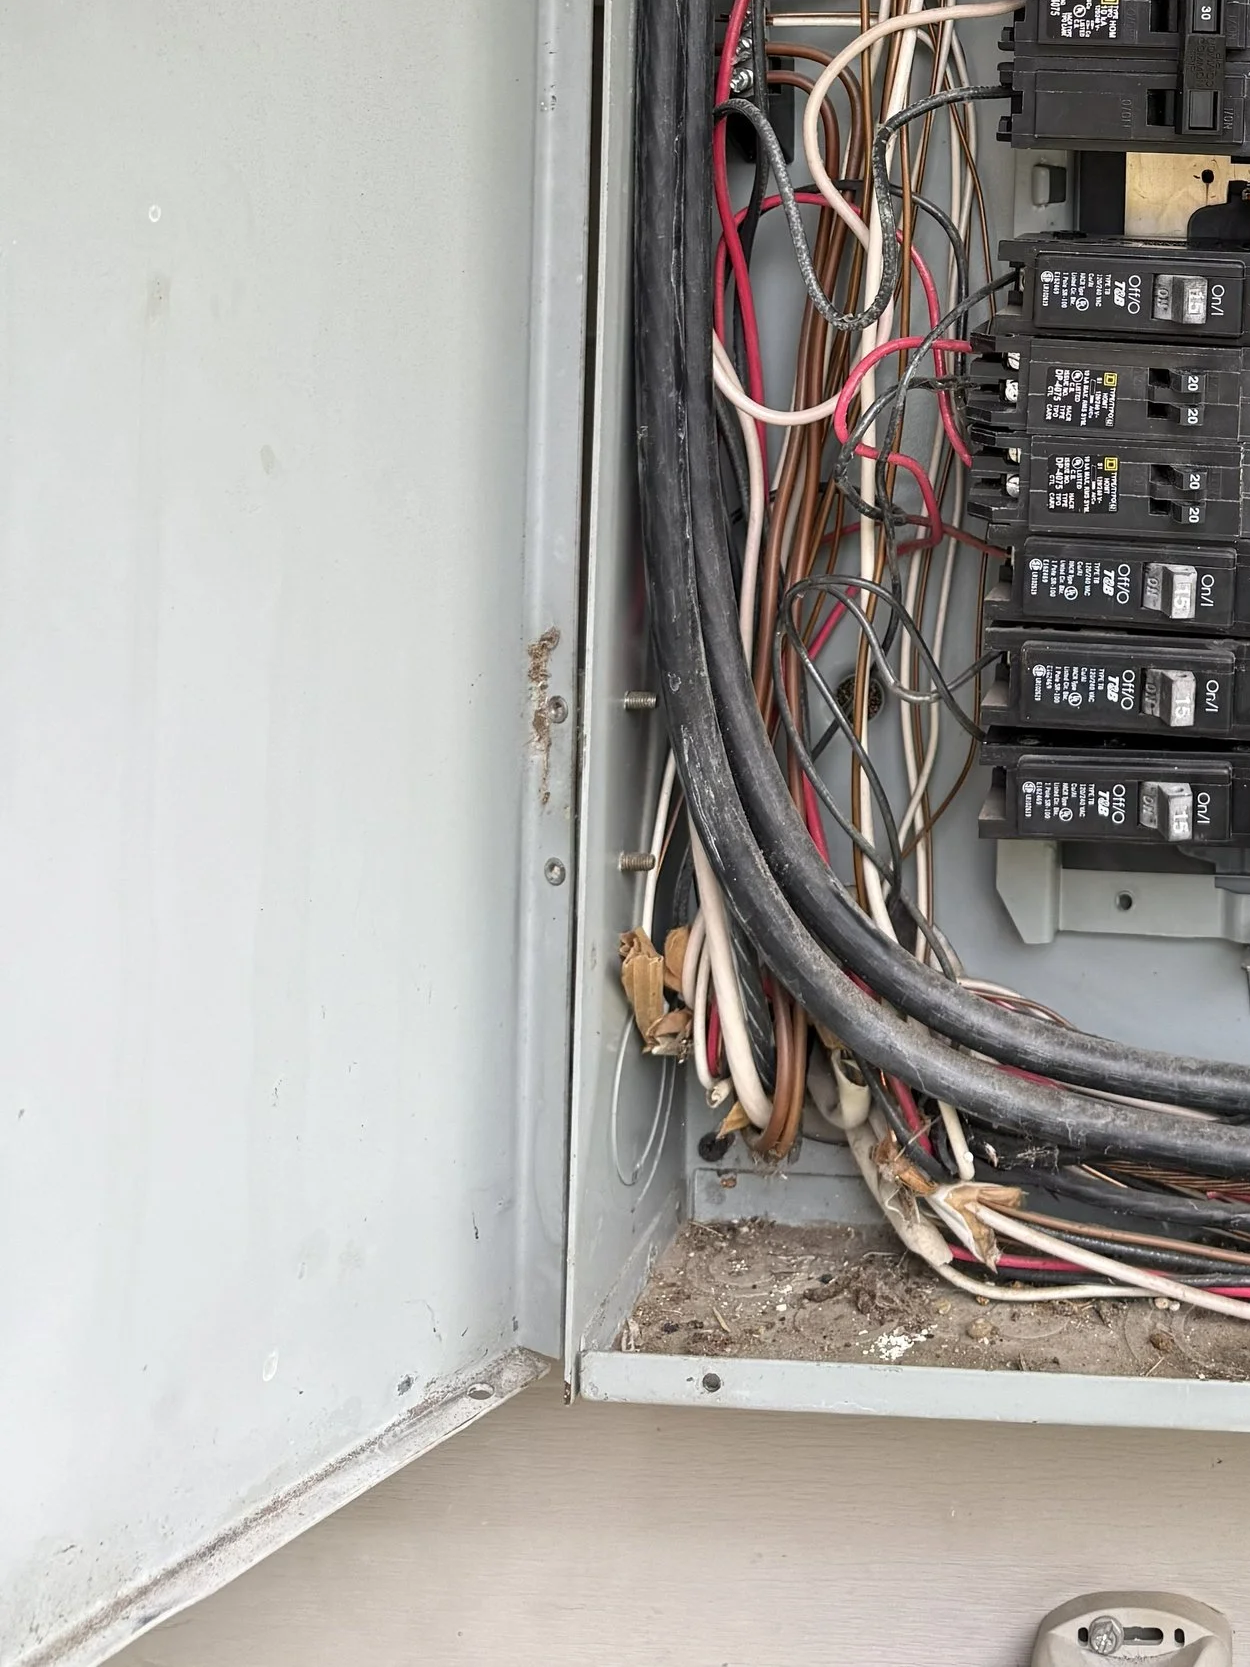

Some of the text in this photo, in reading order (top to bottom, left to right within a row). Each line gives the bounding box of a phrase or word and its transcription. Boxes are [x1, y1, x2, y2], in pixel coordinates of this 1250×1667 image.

[1201, 6, 1211, 20] 30
[1054, 369, 1063, 401] DP-4075
[1188, 376, 1198, 391] 20
[1188, 409, 1198, 424] 20
[1190, 474, 1200, 489] 20
[1189, 508, 1199, 522] 20
[1175, 697, 1192, 718] 15
[1173, 809, 1188, 833] 15
